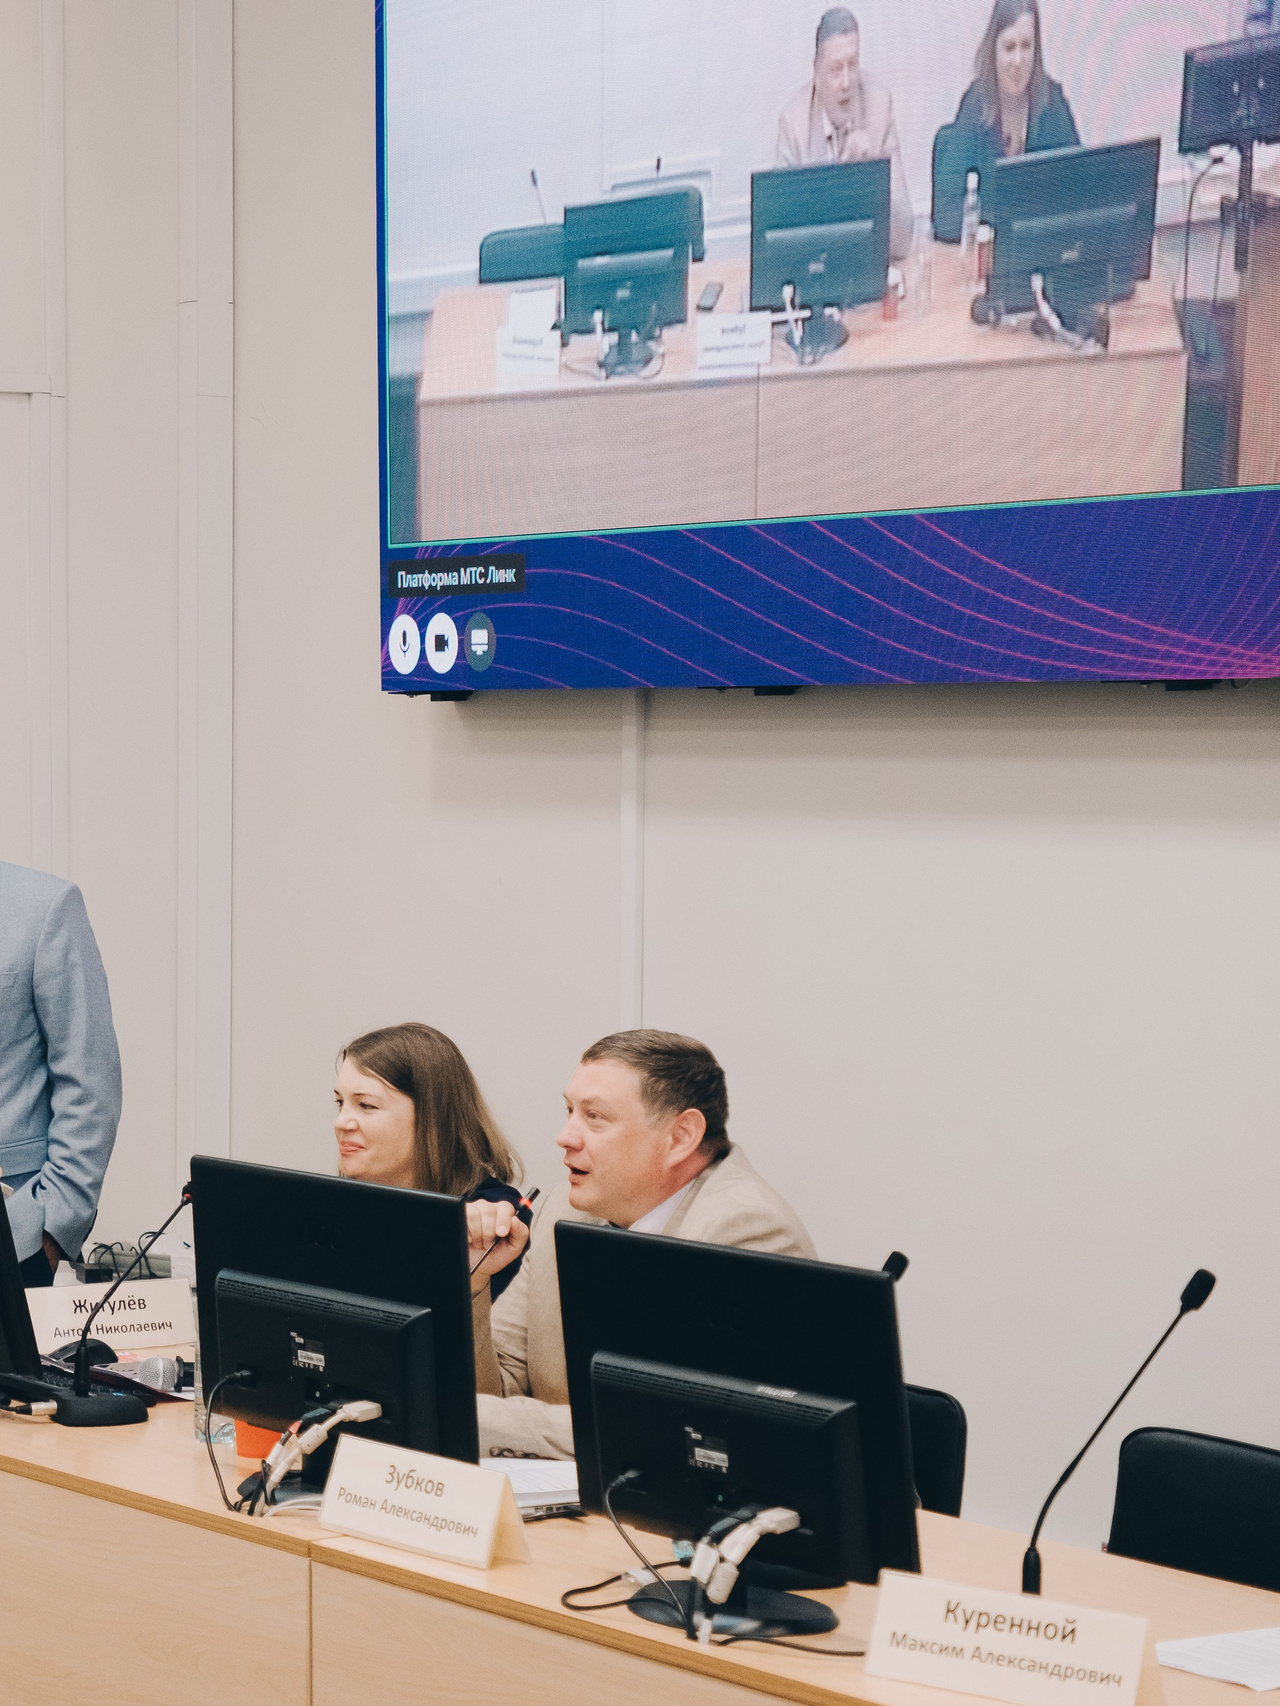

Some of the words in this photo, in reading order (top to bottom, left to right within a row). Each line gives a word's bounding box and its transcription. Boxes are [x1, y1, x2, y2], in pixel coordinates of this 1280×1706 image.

[397, 569, 459, 591] Платформа
[460, 566, 485, 586] МТС
[486, 565, 517, 585] Линк
[95, 1321, 173, 1336] Николаевич
[385, 1464, 446, 1498] Зубков
[337, 1486, 378, 1511] Роман
[379, 1498, 479, 1540] Александрович
[944, 1599, 1078, 1645] Куренной
[888, 1630, 966, 1660] Максим
[970, 1645, 1123, 1689] Александрович
